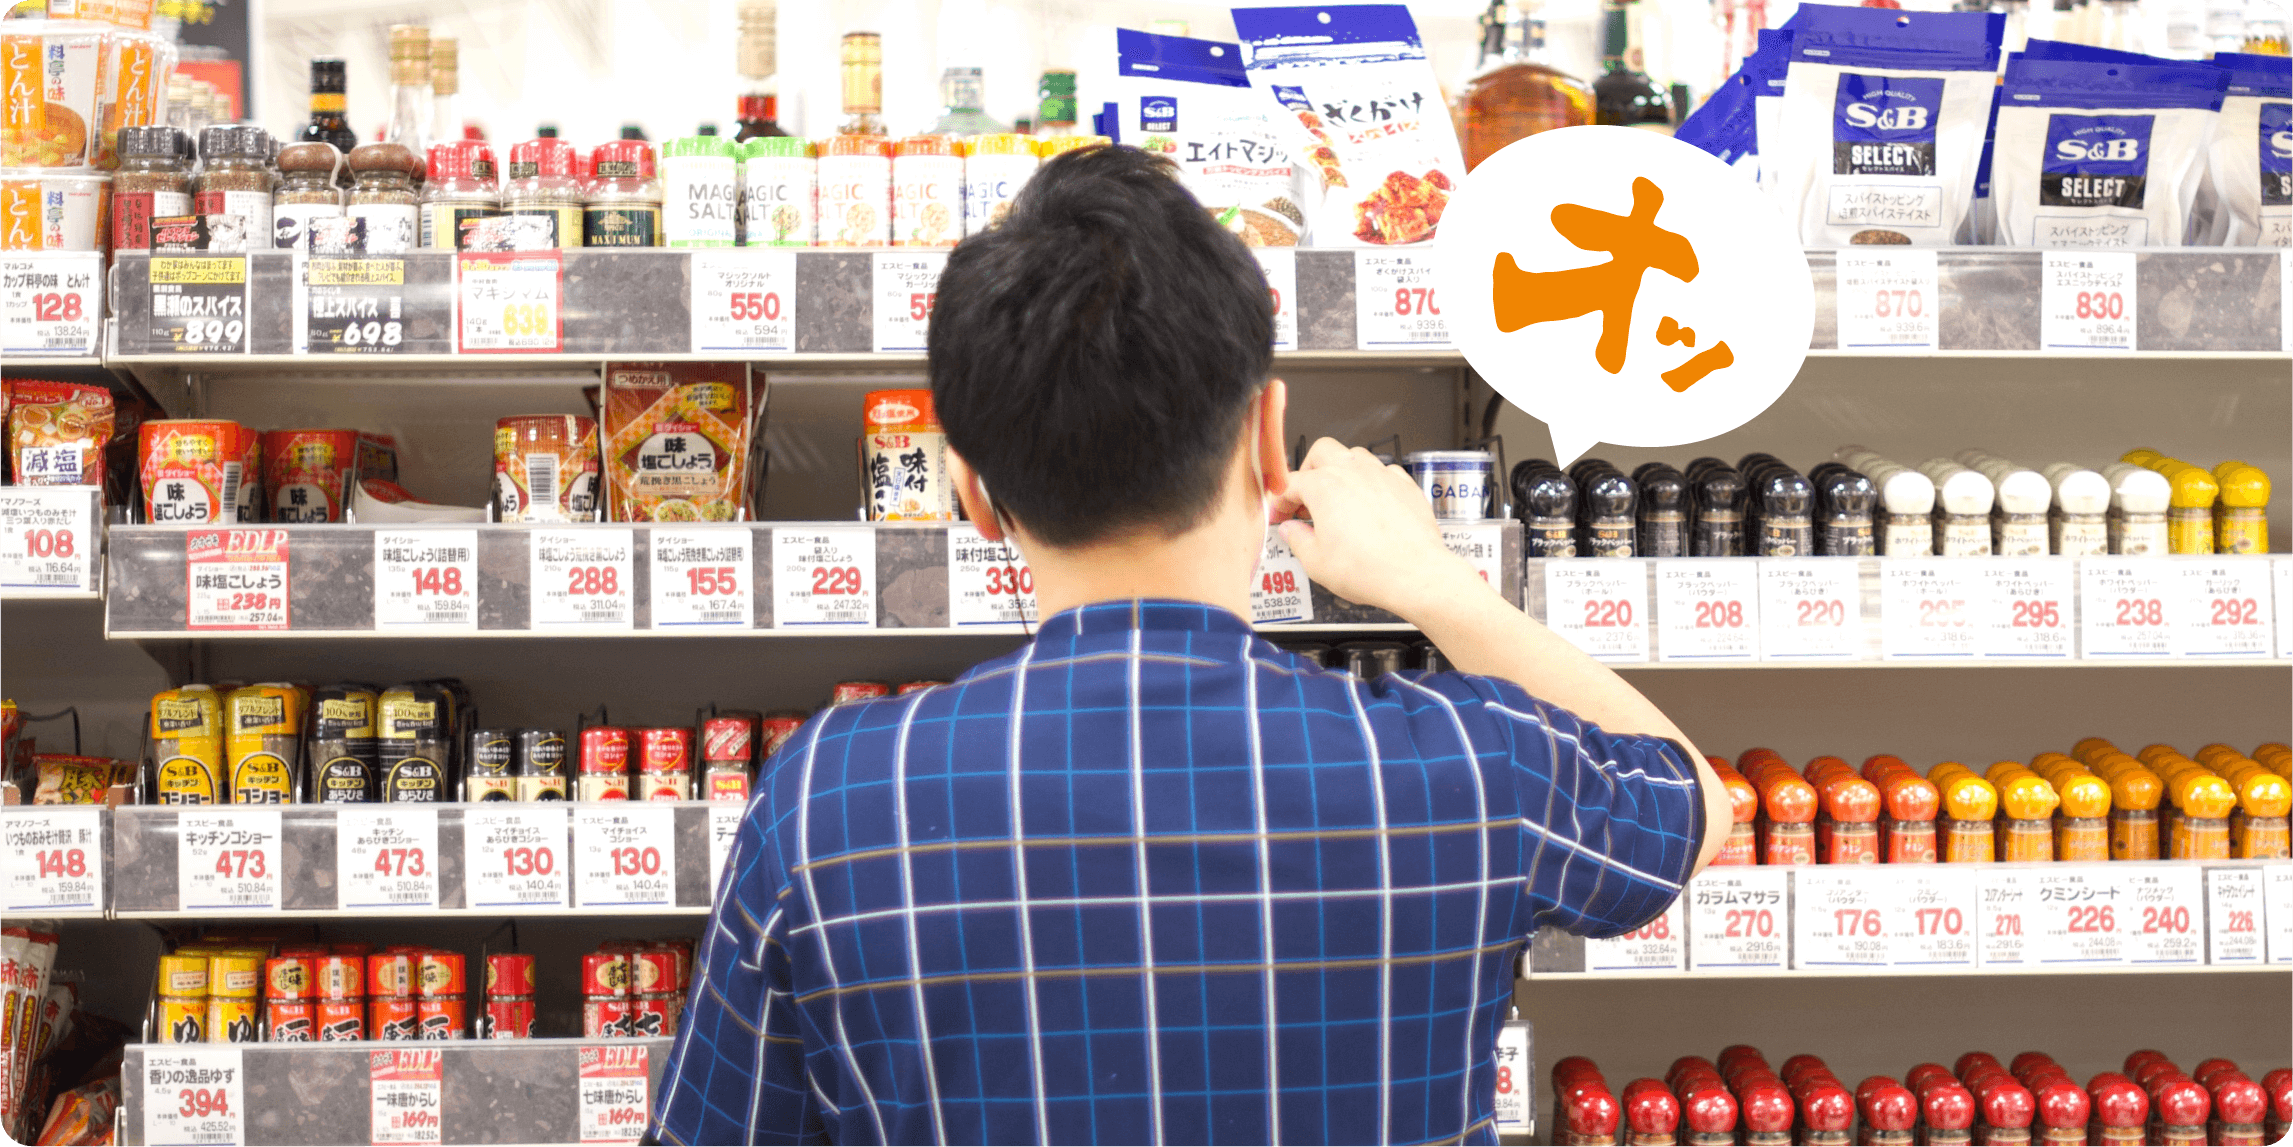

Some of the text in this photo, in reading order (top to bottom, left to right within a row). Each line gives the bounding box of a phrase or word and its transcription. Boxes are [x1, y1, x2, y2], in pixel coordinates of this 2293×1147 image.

[9, 42, 36, 125] とん汁
[1863, 91, 1916, 102] HIGH QUALITY
[1144, 104, 1174, 118] S&B
[1323, 92, 1425, 125] ざくがけ
[1847, 102, 1927, 130] S&B
[2074, 127, 2126, 136] HIGH QUALITY
[1186, 140, 1288, 163] エイトマジッ
[1851, 145, 1914, 166] SELECT
[2056, 138, 2138, 161] S&B
[2062, 177, 2125, 198] SELECT
[1844, 193, 1924, 206] スパイストッピング
[1838, 206, 1931, 221] 焙煎スパイステイスト
[2050, 224, 2129, 237] スパイストッピング
[592, 236, 640, 244] MAXIMUM
[4, 274, 89, 288] カップ料亭の味 とん汁
[2056, 271, 2123, 279] スパイストッピング
[2056, 279, 2123, 287] エスニックテイスト
[473, 288, 549, 299] マキシマム
[153, 295, 242, 317] 黒瀬のスパイス
[313, 297, 378, 318] 極上スパイス
[665, 437, 686, 453] 味
[875, 435, 911, 448] S&B
[26, 449, 77, 472] 減塩
[642, 454, 712, 469] 塩こしょう
[900, 447, 928, 493] 味付
[6, 517, 72, 525] 三つ葉入り赤だし
[226, 530, 288, 554] EDLP
[1442, 532, 1471, 541] ギャバン
[193, 574, 282, 589] 味塩こしょう
[167, 765, 197, 777] S&B
[248, 762, 278, 773] S&B
[330, 765, 362, 776] S&B
[401, 766, 432, 777] S&B
[166, 778, 197, 787] キッチン
[247, 776, 277, 784] キッチン
[330, 778, 362, 787] キッチン
[401, 779, 433, 788] キッチン
[328, 790, 363, 800] あらびき
[398, 791, 434, 801] あらびき
[6, 830, 92, 845] いつものおみそ汁贅沢 豚汁
[186, 830, 273, 845] キッチンコショー
[357, 836, 419, 844] あらびきコショー
[1697, 892, 1779, 905] ガラムマサラ
[2040, 887, 2120, 901] クミンシード
[398, 1049, 441, 1071] EDLP
[605, 1046, 648, 1069] EDLP
[149, 1070, 235, 1085] 香りの逸品ゆず
[376, 1092, 436, 1107] 一味唐からし
[583, 1090, 643, 1106] 七味唐からし
